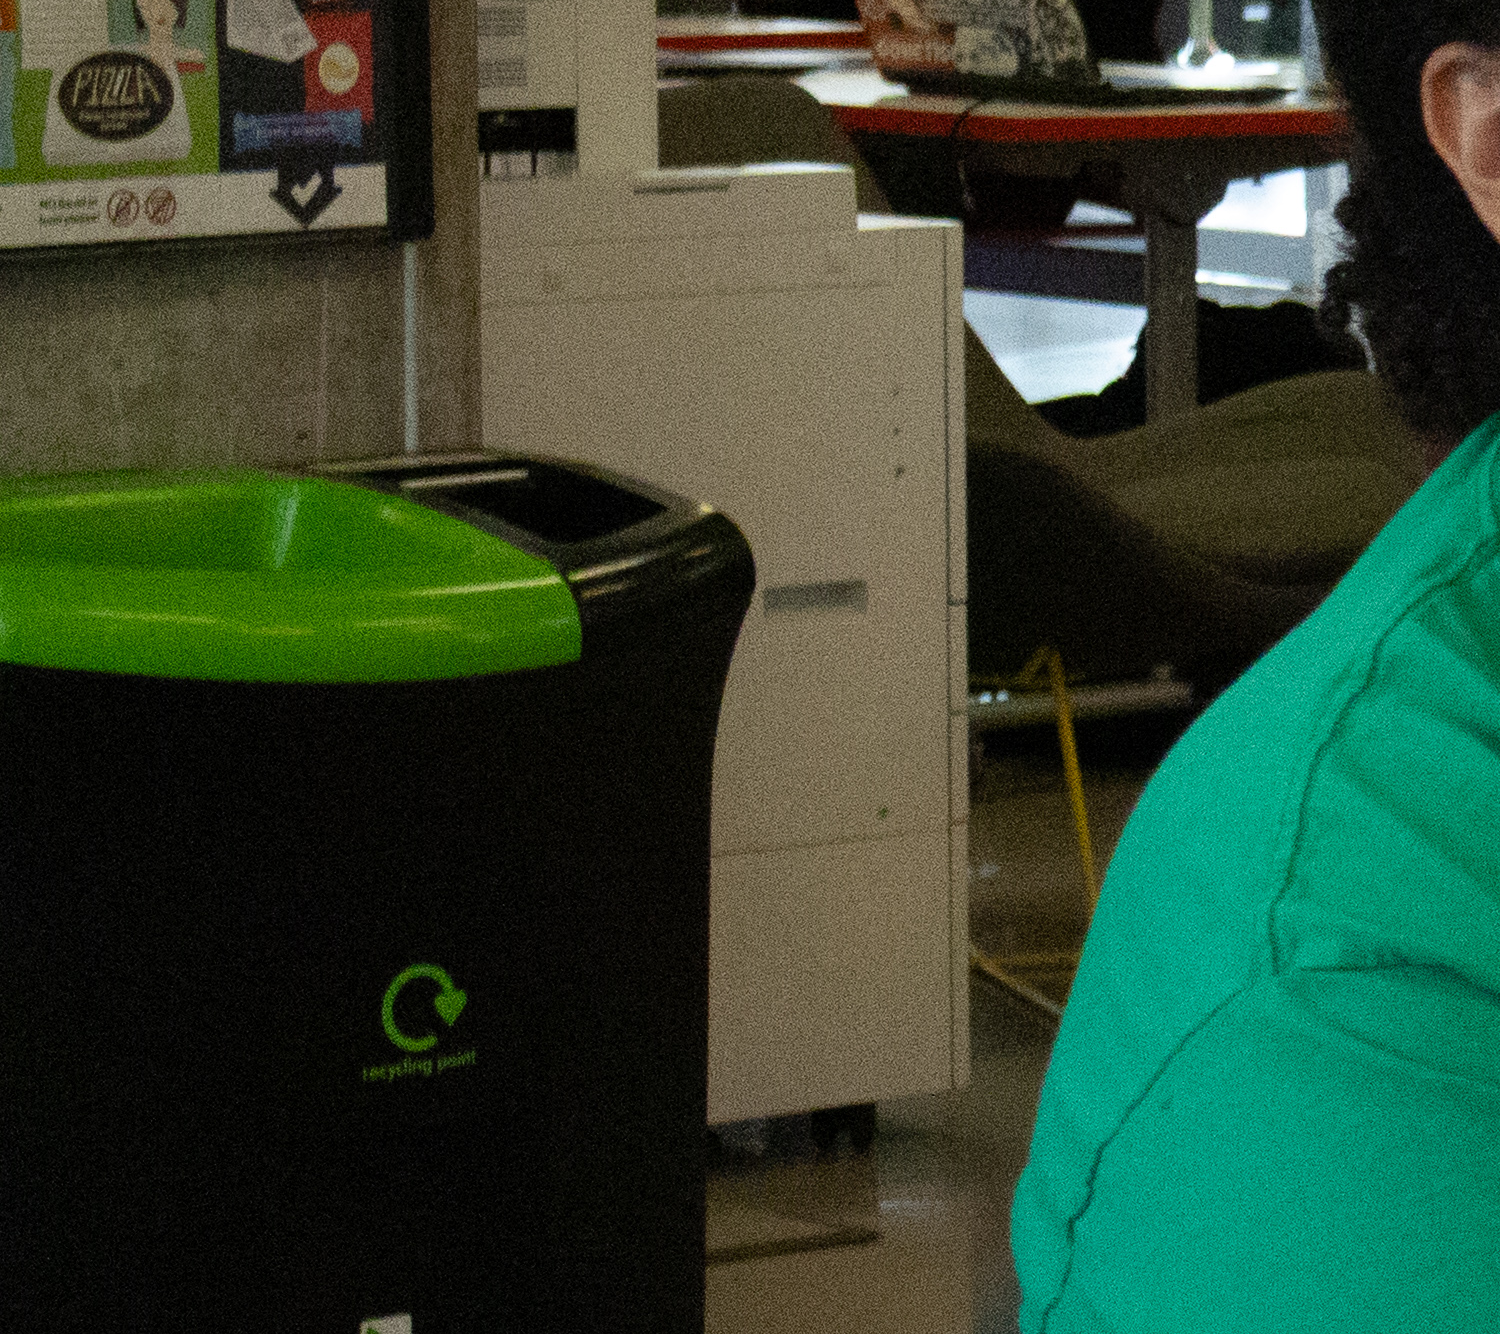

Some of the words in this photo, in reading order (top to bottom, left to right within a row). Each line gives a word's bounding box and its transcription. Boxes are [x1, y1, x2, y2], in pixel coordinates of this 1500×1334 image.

[73, 62, 163, 107] PIZZA
[362, 1055, 433, 1083] recycling
[437, 1049, 477, 1074] point
